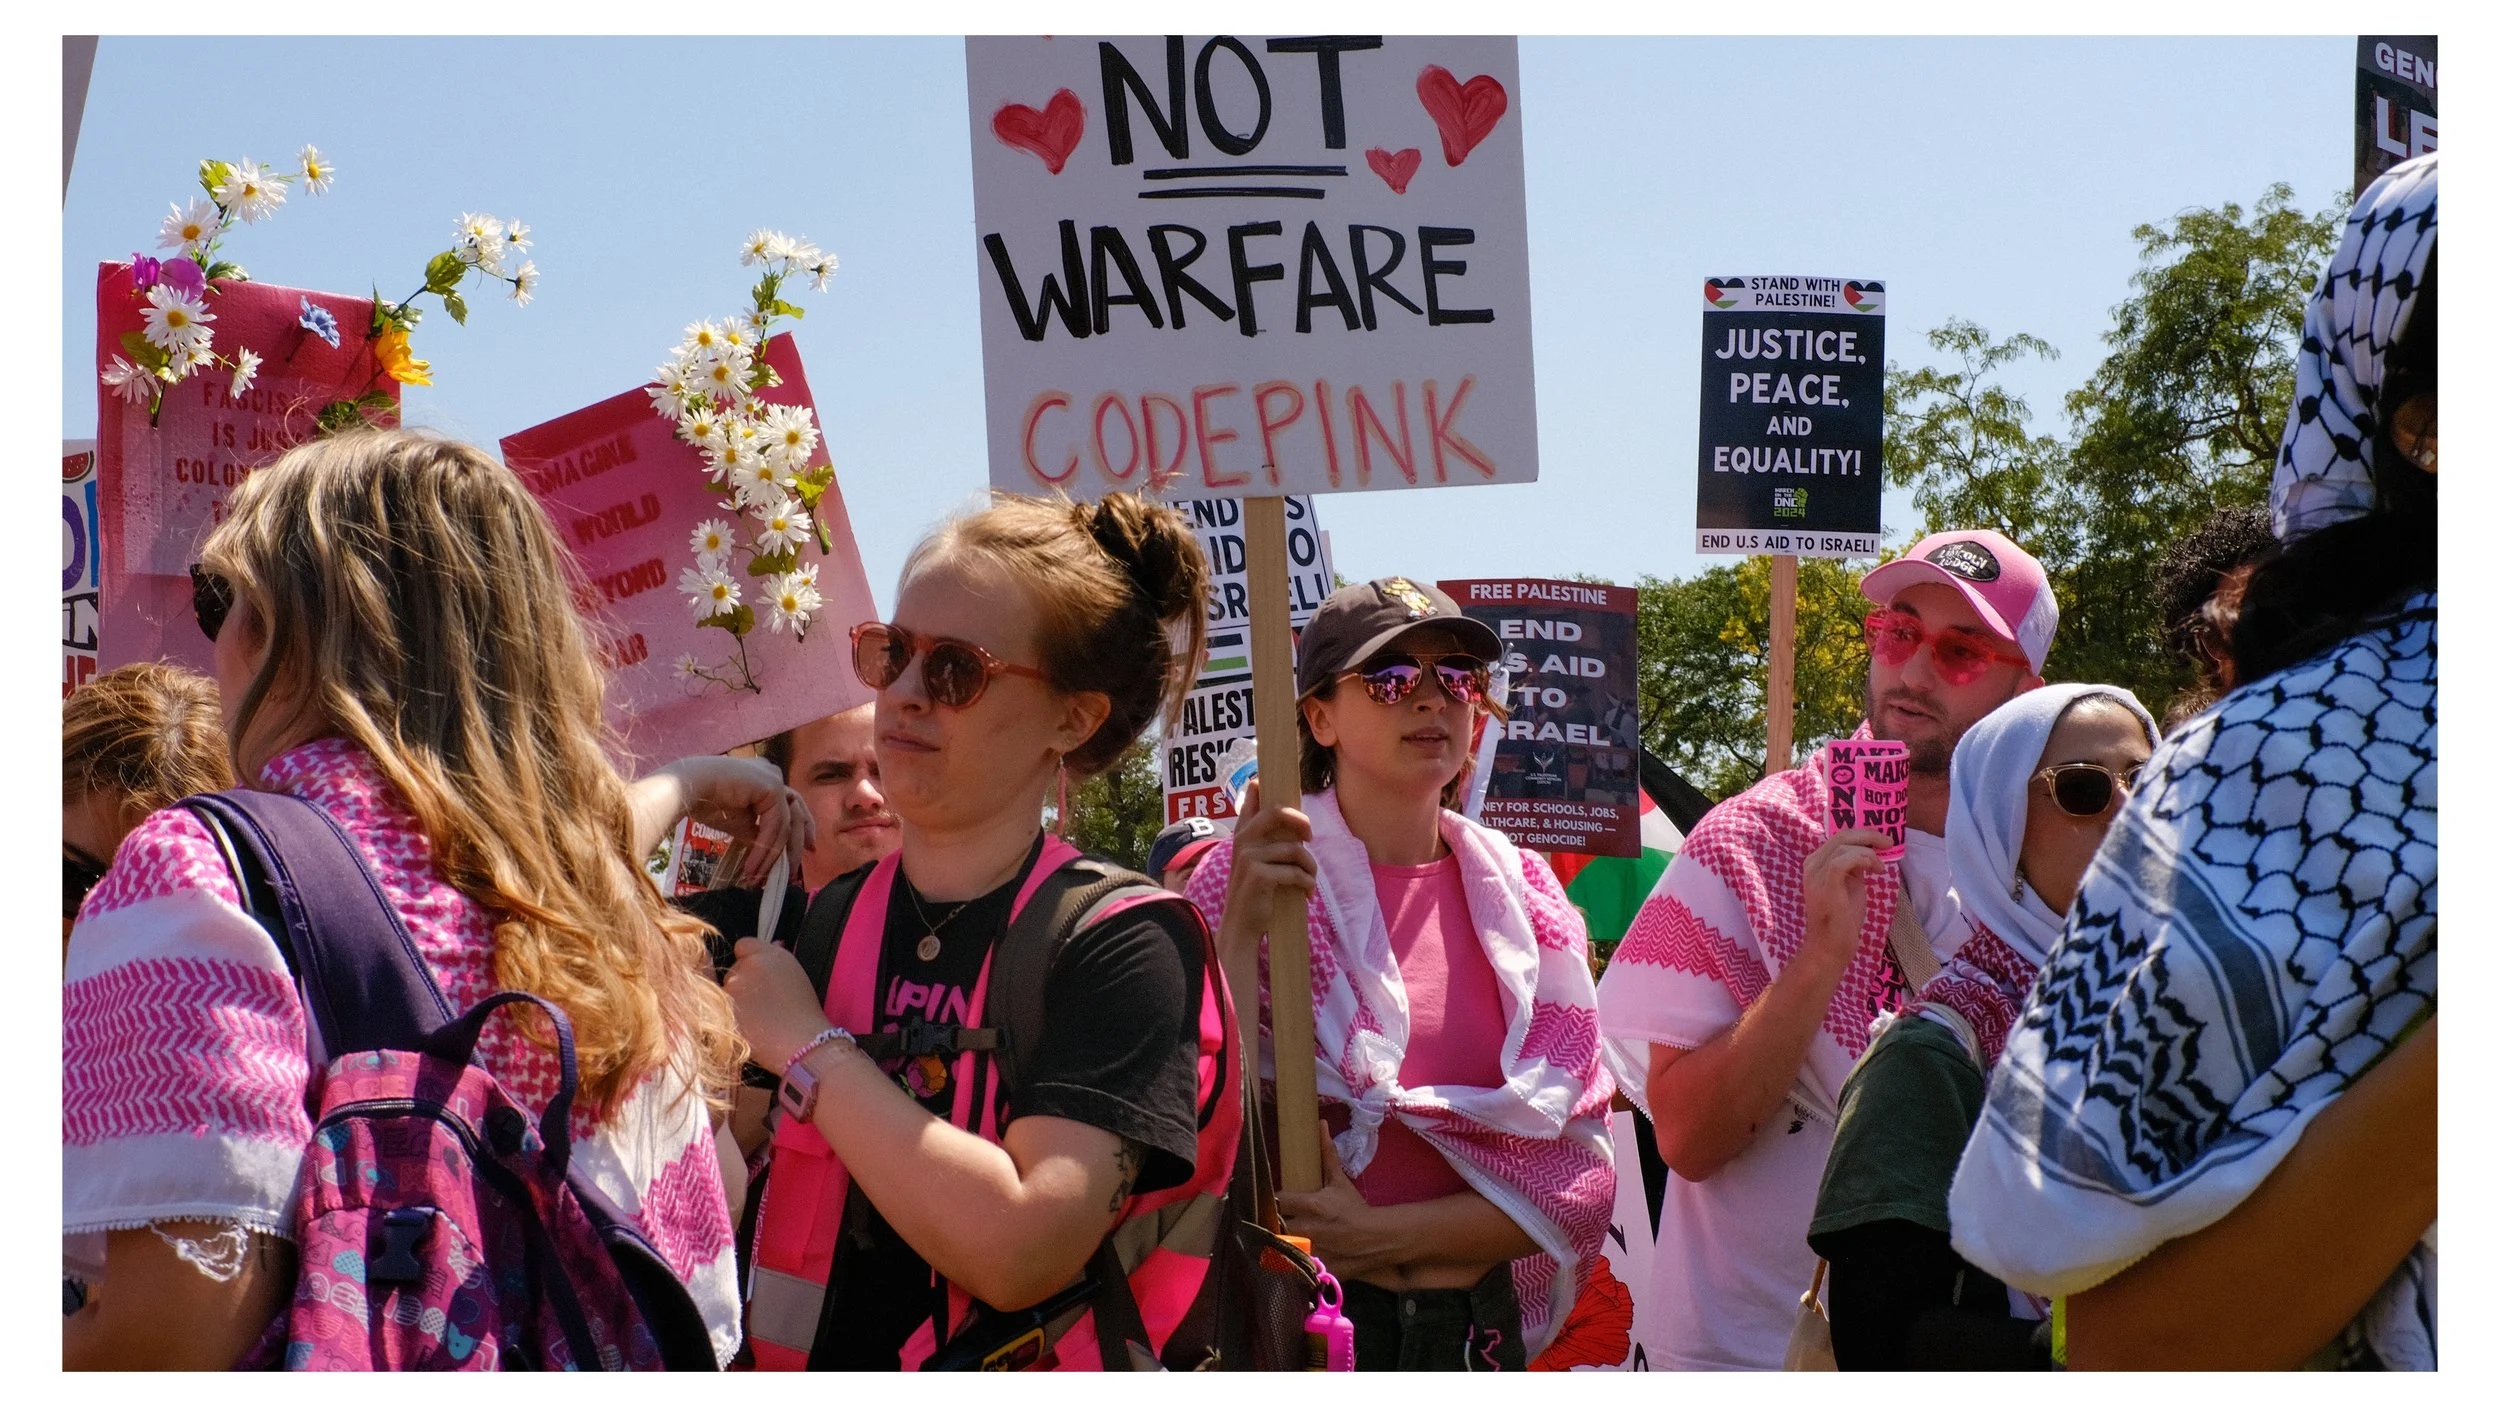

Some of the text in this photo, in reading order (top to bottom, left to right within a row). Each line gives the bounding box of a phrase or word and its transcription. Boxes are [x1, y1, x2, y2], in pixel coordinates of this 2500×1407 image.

[2375, 42, 2438, 88] GEN
[1099, 36, 1383, 165] NOT
[983, 218, 1495, 341] WARFARE
[1751, 277, 1841, 293] STAND WITH
[1755, 293, 1835, 308] PALESTINE!
[1714, 328, 1867, 366] JUSTICE,
[1729, 372, 1850, 409] PEACE,
[212, 421, 236, 449] IS
[1021, 372, 1497, 490] CODEPINK
[1766, 415, 1813, 436] AND
[1713, 446, 1862, 477] EQUALITY!
[1774, 507, 1806, 518] 2024
[1701, 535, 1731, 550] END
[1764, 535, 1791, 551] AID
[1795, 536, 1816, 551] TO
[1820, 537, 1875, 554] ISRAEL!
[1938, 557, 1977, 577] LODGE
[1470, 583, 1608, 606] FREE PALESTINE
[1500, 619, 1583, 642] END
[1539, 654, 1606, 678] AID
[1522, 686, 1568, 708] TO
[1178, 792, 1227, 819] FRS
[1864, 788, 1892, 806] HOT
[1506, 802, 1530, 813] FOR
[1533, 803, 1588, 817] SCHOOLS,
[1589, 807, 1620, 820] JOBS,
[1863, 806, 1908, 827] NOT
[1184, 816, 1215, 838] B
[1542, 818, 1552, 828] &
[1553, 820, 1603, 832] HOUSING
[1526, 833, 1587, 846] GENOCIDE!
